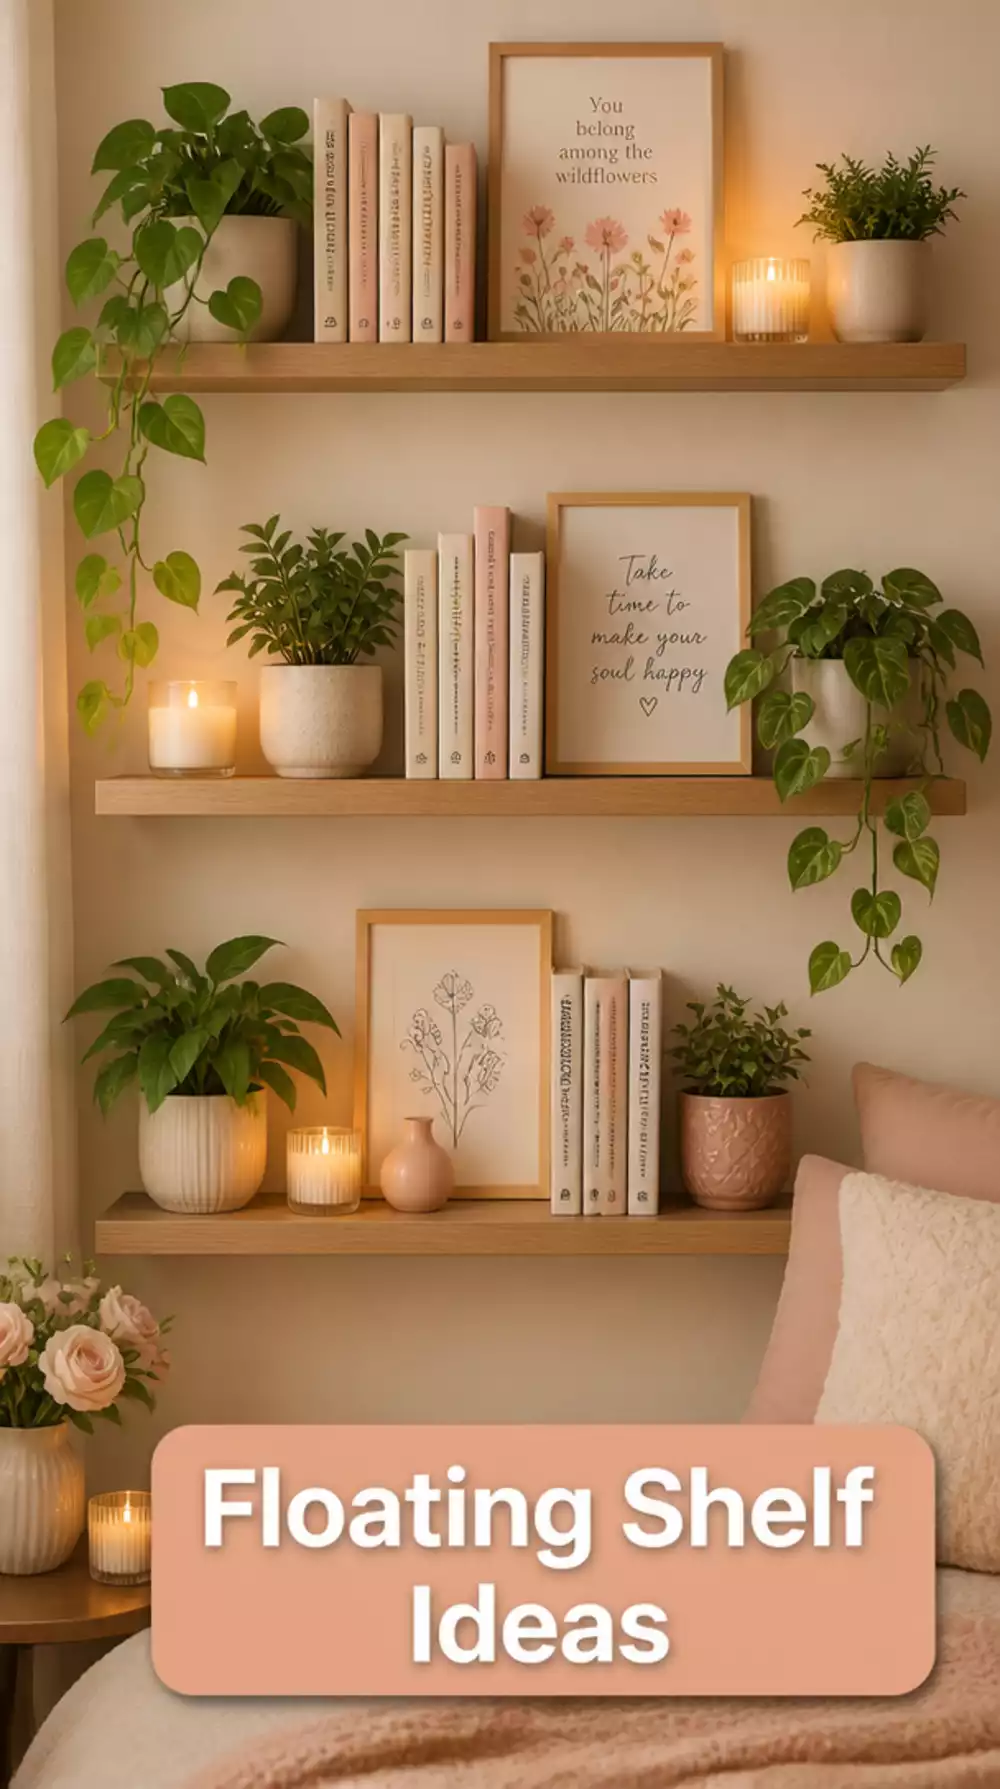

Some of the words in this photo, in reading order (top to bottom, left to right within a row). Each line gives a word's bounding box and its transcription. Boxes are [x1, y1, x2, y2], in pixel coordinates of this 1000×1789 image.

[589, 96, 624, 114] You
[576, 120, 635, 140] belong
[558, 146, 618, 164] among
[625, 144, 653, 160] the
[555, 167, 658, 184] wildflowers
[619, 554, 672, 586] Take
[606, 589, 659, 615] time
[666, 589, 690, 615] to
[591, 622, 648, 646] make
[657, 634, 707, 657] your
[590, 655, 635, 684] soul
[643, 656, 707, 694] happy
